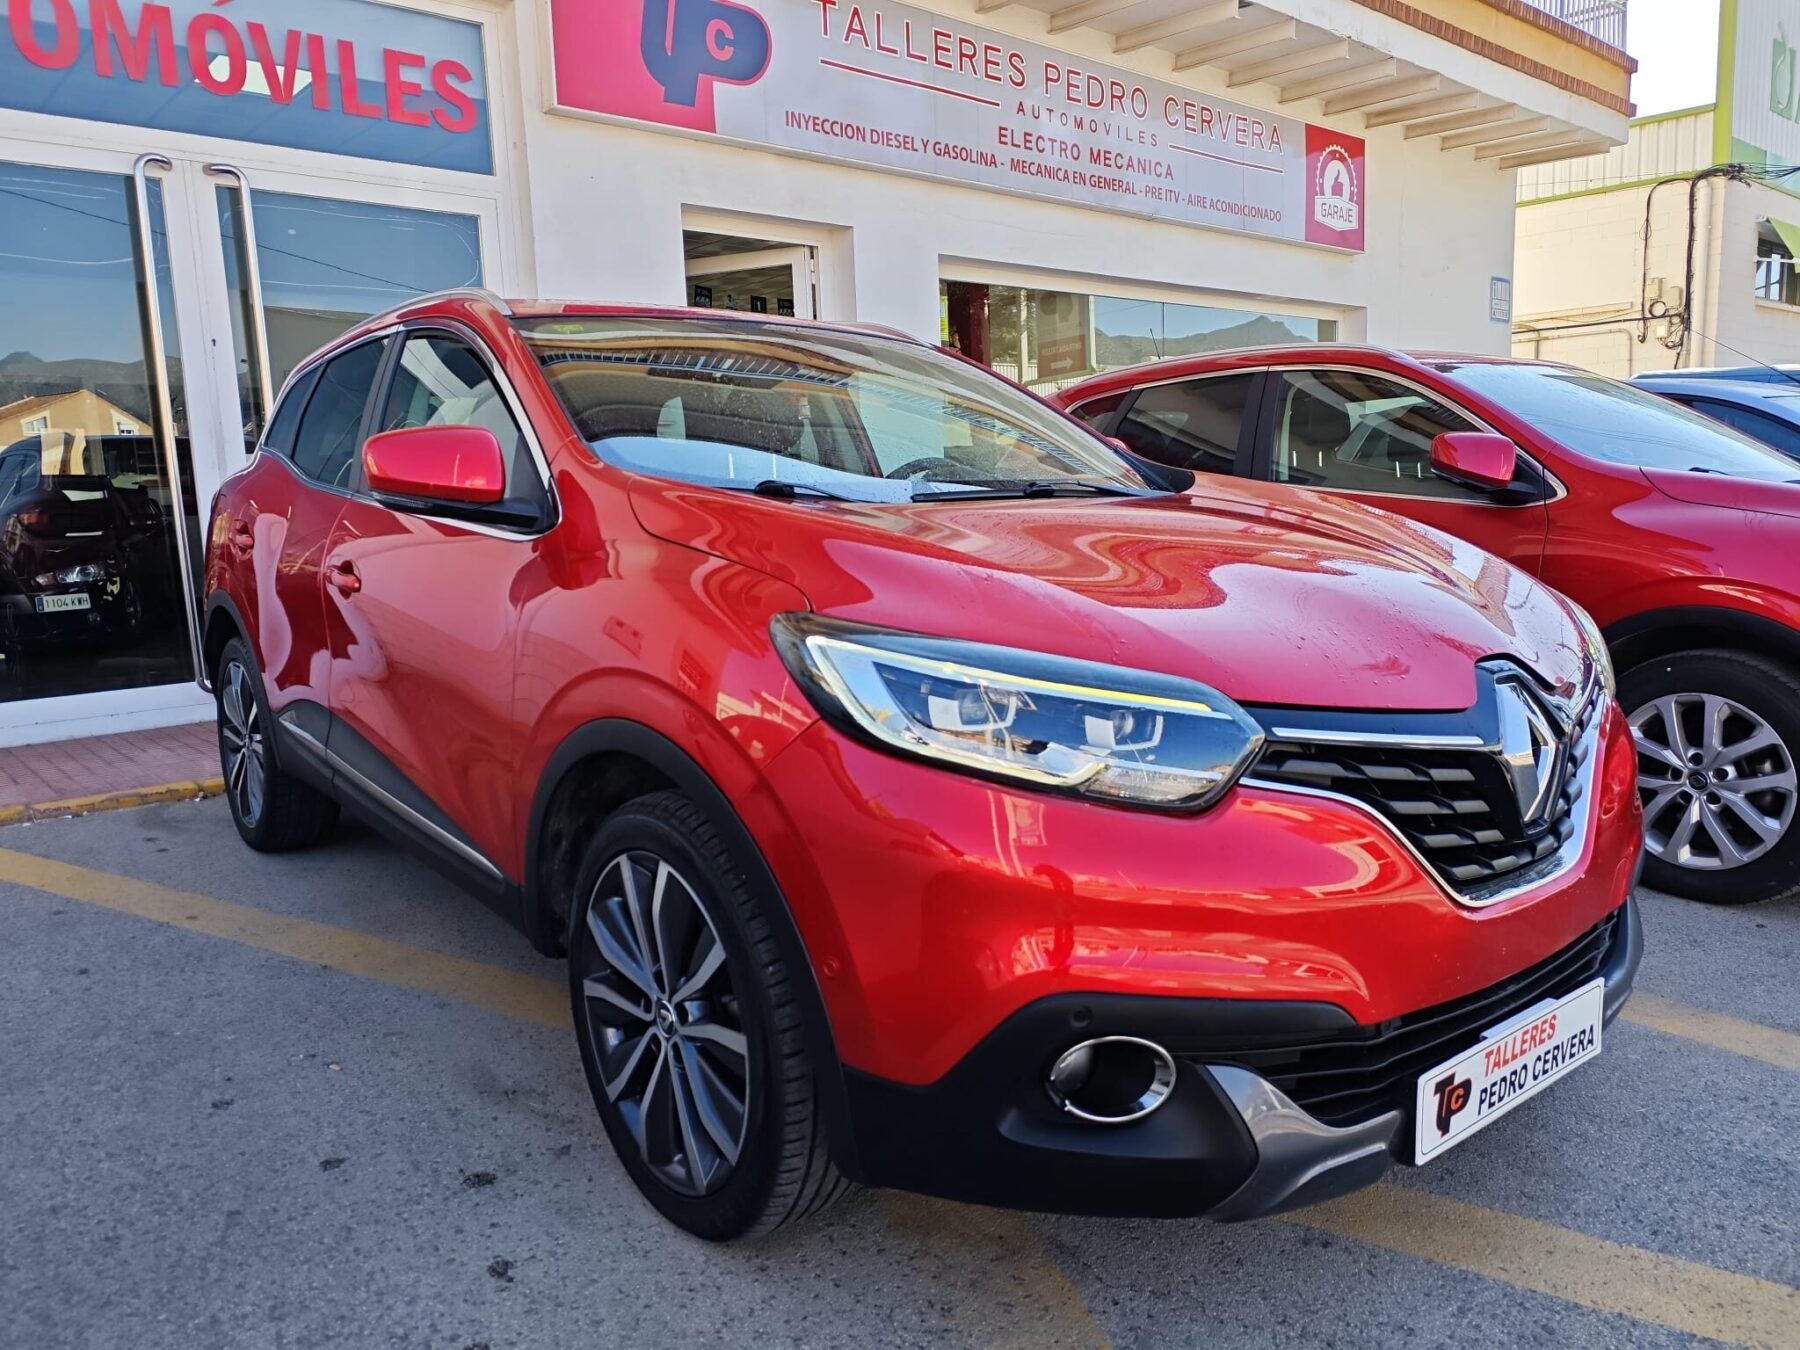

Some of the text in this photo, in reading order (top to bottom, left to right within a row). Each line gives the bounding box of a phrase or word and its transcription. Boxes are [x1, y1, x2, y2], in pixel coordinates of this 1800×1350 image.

[819, 0, 1286, 155] TALLERES PEDRO CERVERA
[998, 126, 1174, 181] ELECTRO MECANICA
[1016, 101, 1158, 147] AUTOMOVILES
[785, 110, 867, 143] INYECCION
[870, 128, 918, 152] DIESEL
[921, 138, 930, 154] Y
[933, 141, 997, 169] GASOLINA
[1010, 158, 1070, 184] MECANICA
[1073, 171, 1087, 186] EN
[1089, 174, 1137, 196] GENERAL
[1145, 185, 1163, 201] PRE
[1164, 189, 1180, 204] ITV
[1187, 195, 1208, 210] AIRE
[1209, 198, 1282, 223] ACONDICIONADO
[1321, 202, 1354, 223] GARAJE
[45, 597, 69, 609] 1104
[1478, 1024, 1594, 1116] PEDRO CERVERA
[1484, 1014, 1557, 1077] TALLERES
